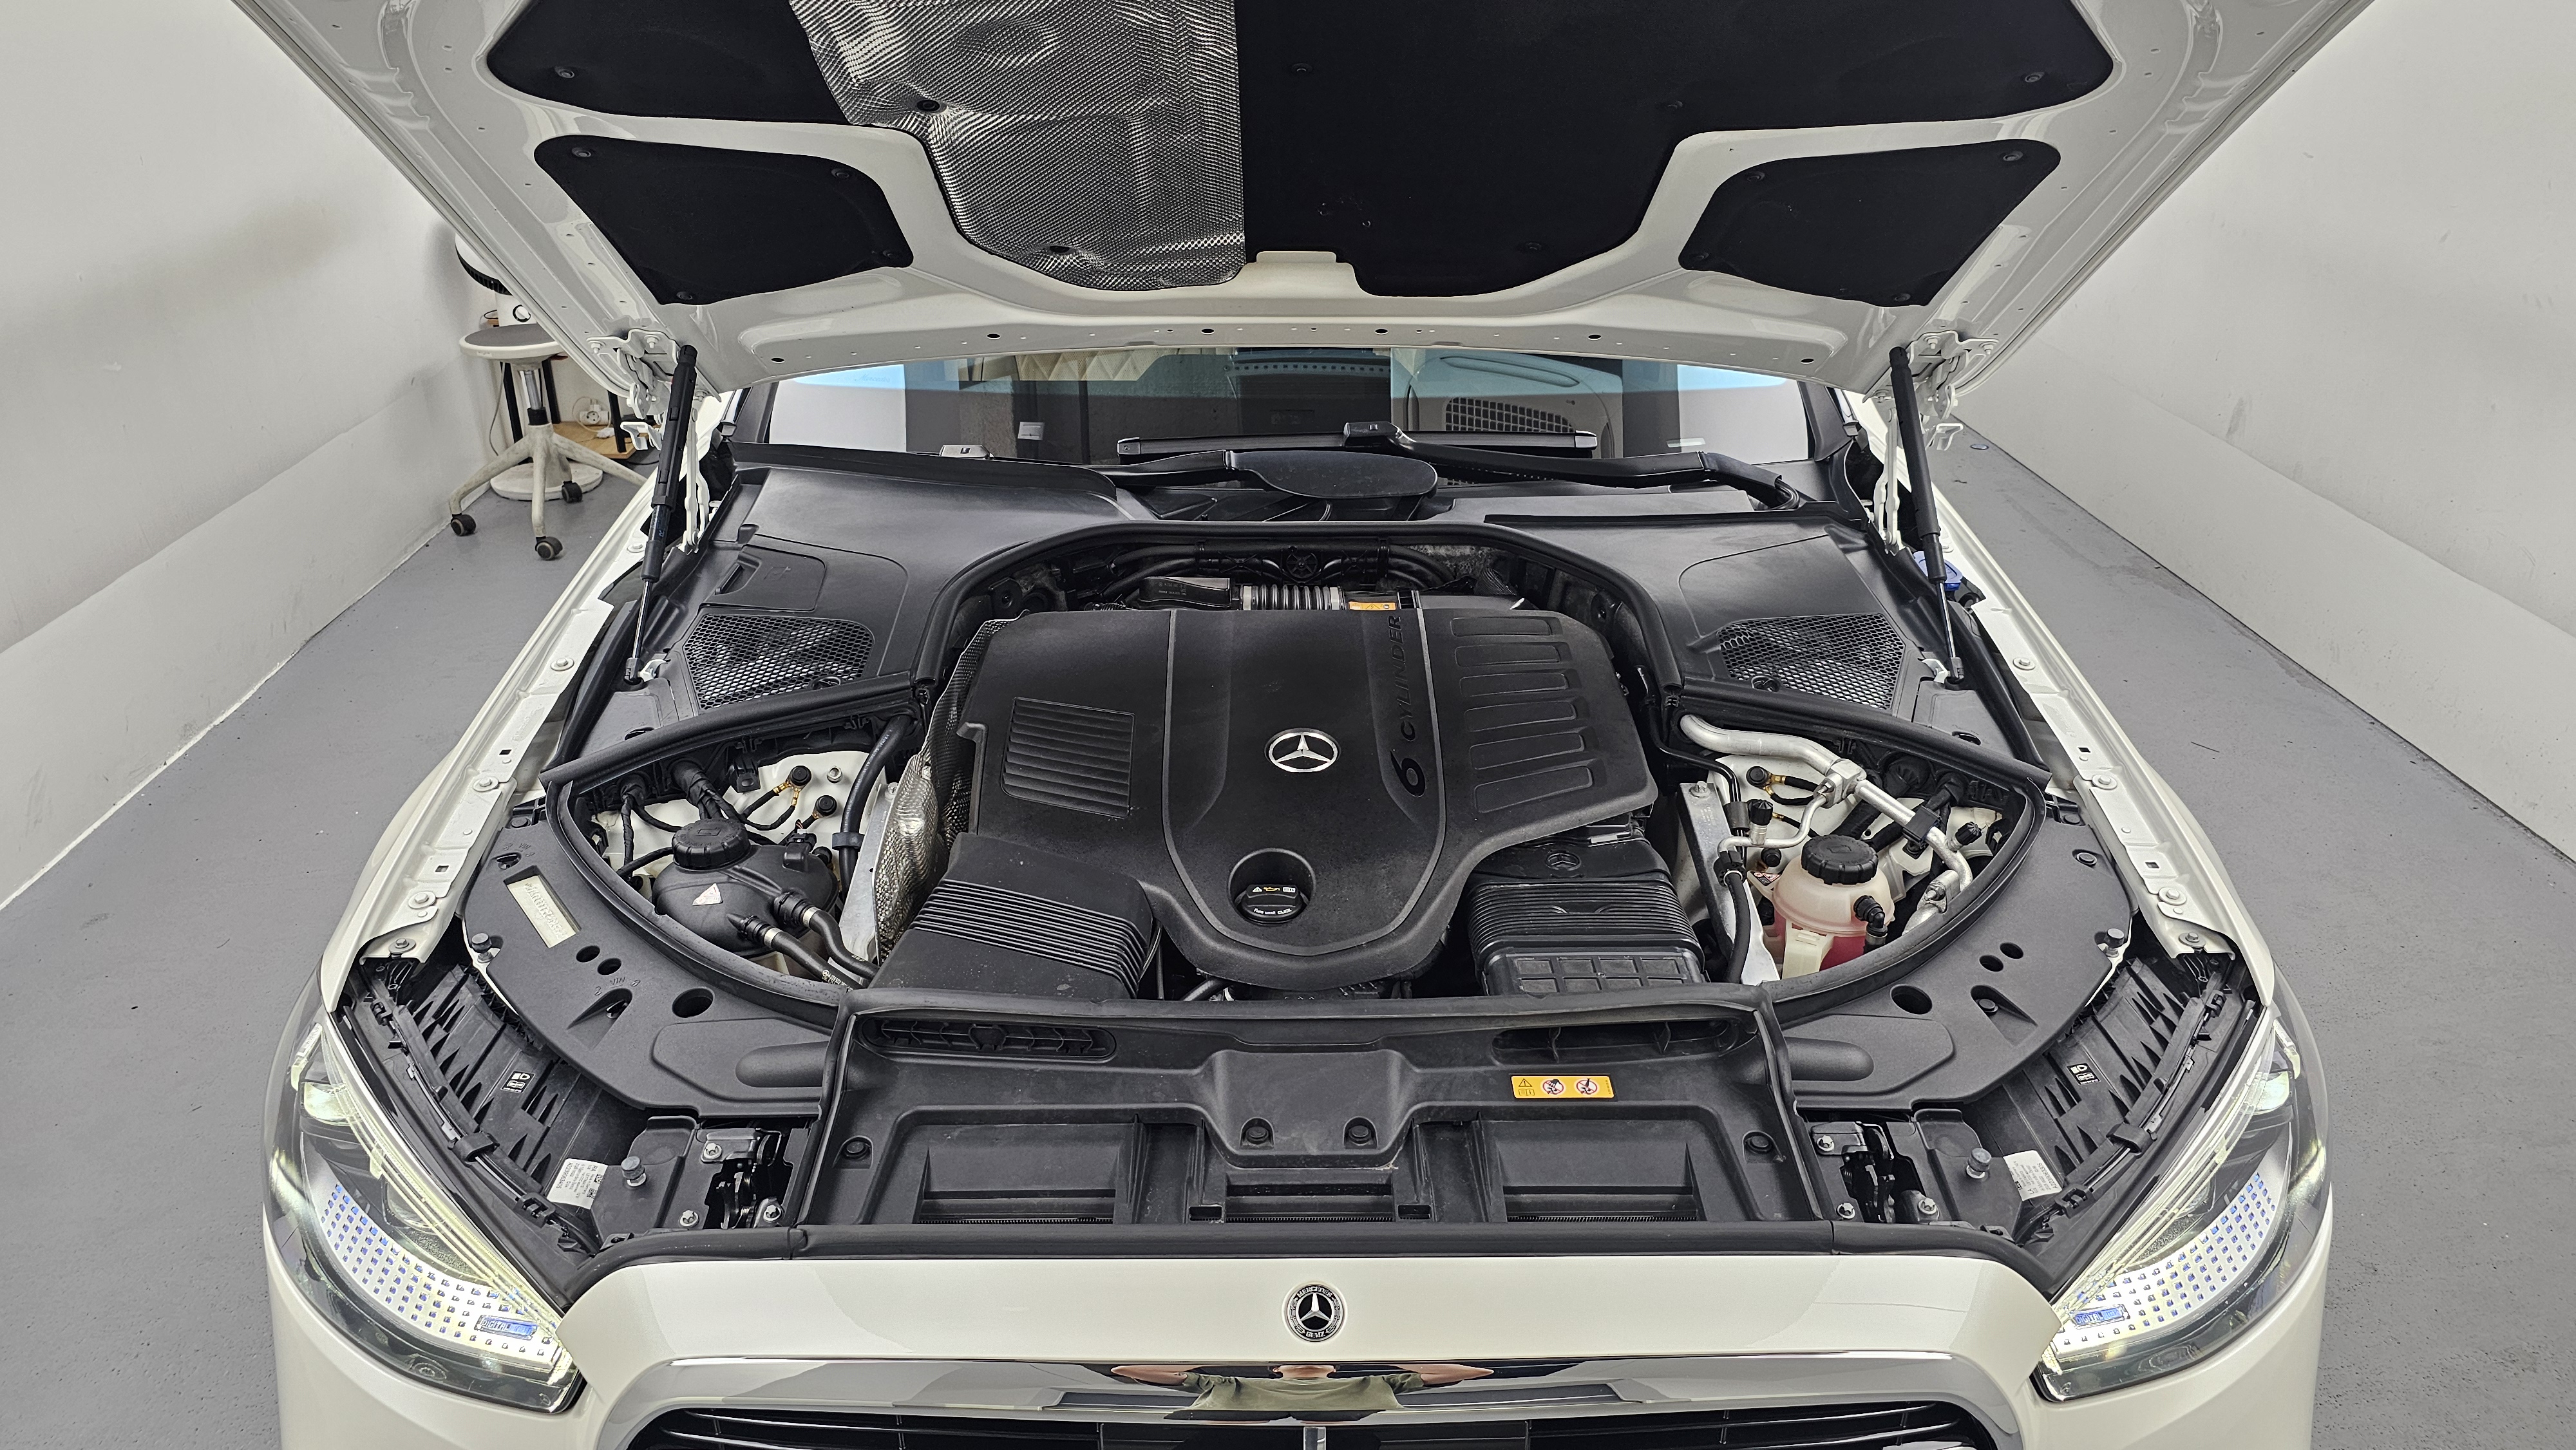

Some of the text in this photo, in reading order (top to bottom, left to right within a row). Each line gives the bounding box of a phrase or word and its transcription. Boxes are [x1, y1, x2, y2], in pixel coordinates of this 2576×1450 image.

[1388, 615, 1426, 798] 6 CYLINDER
[609, 976, 626, 985] VIN
[1296, 1286, 1333, 1297] MERCEDES
[2074, 1312, 2104, 1324] DIGITAL
[481, 1319, 511, 1332] DIGITAL
[1305, 1330, 1326, 1339] BENZ
